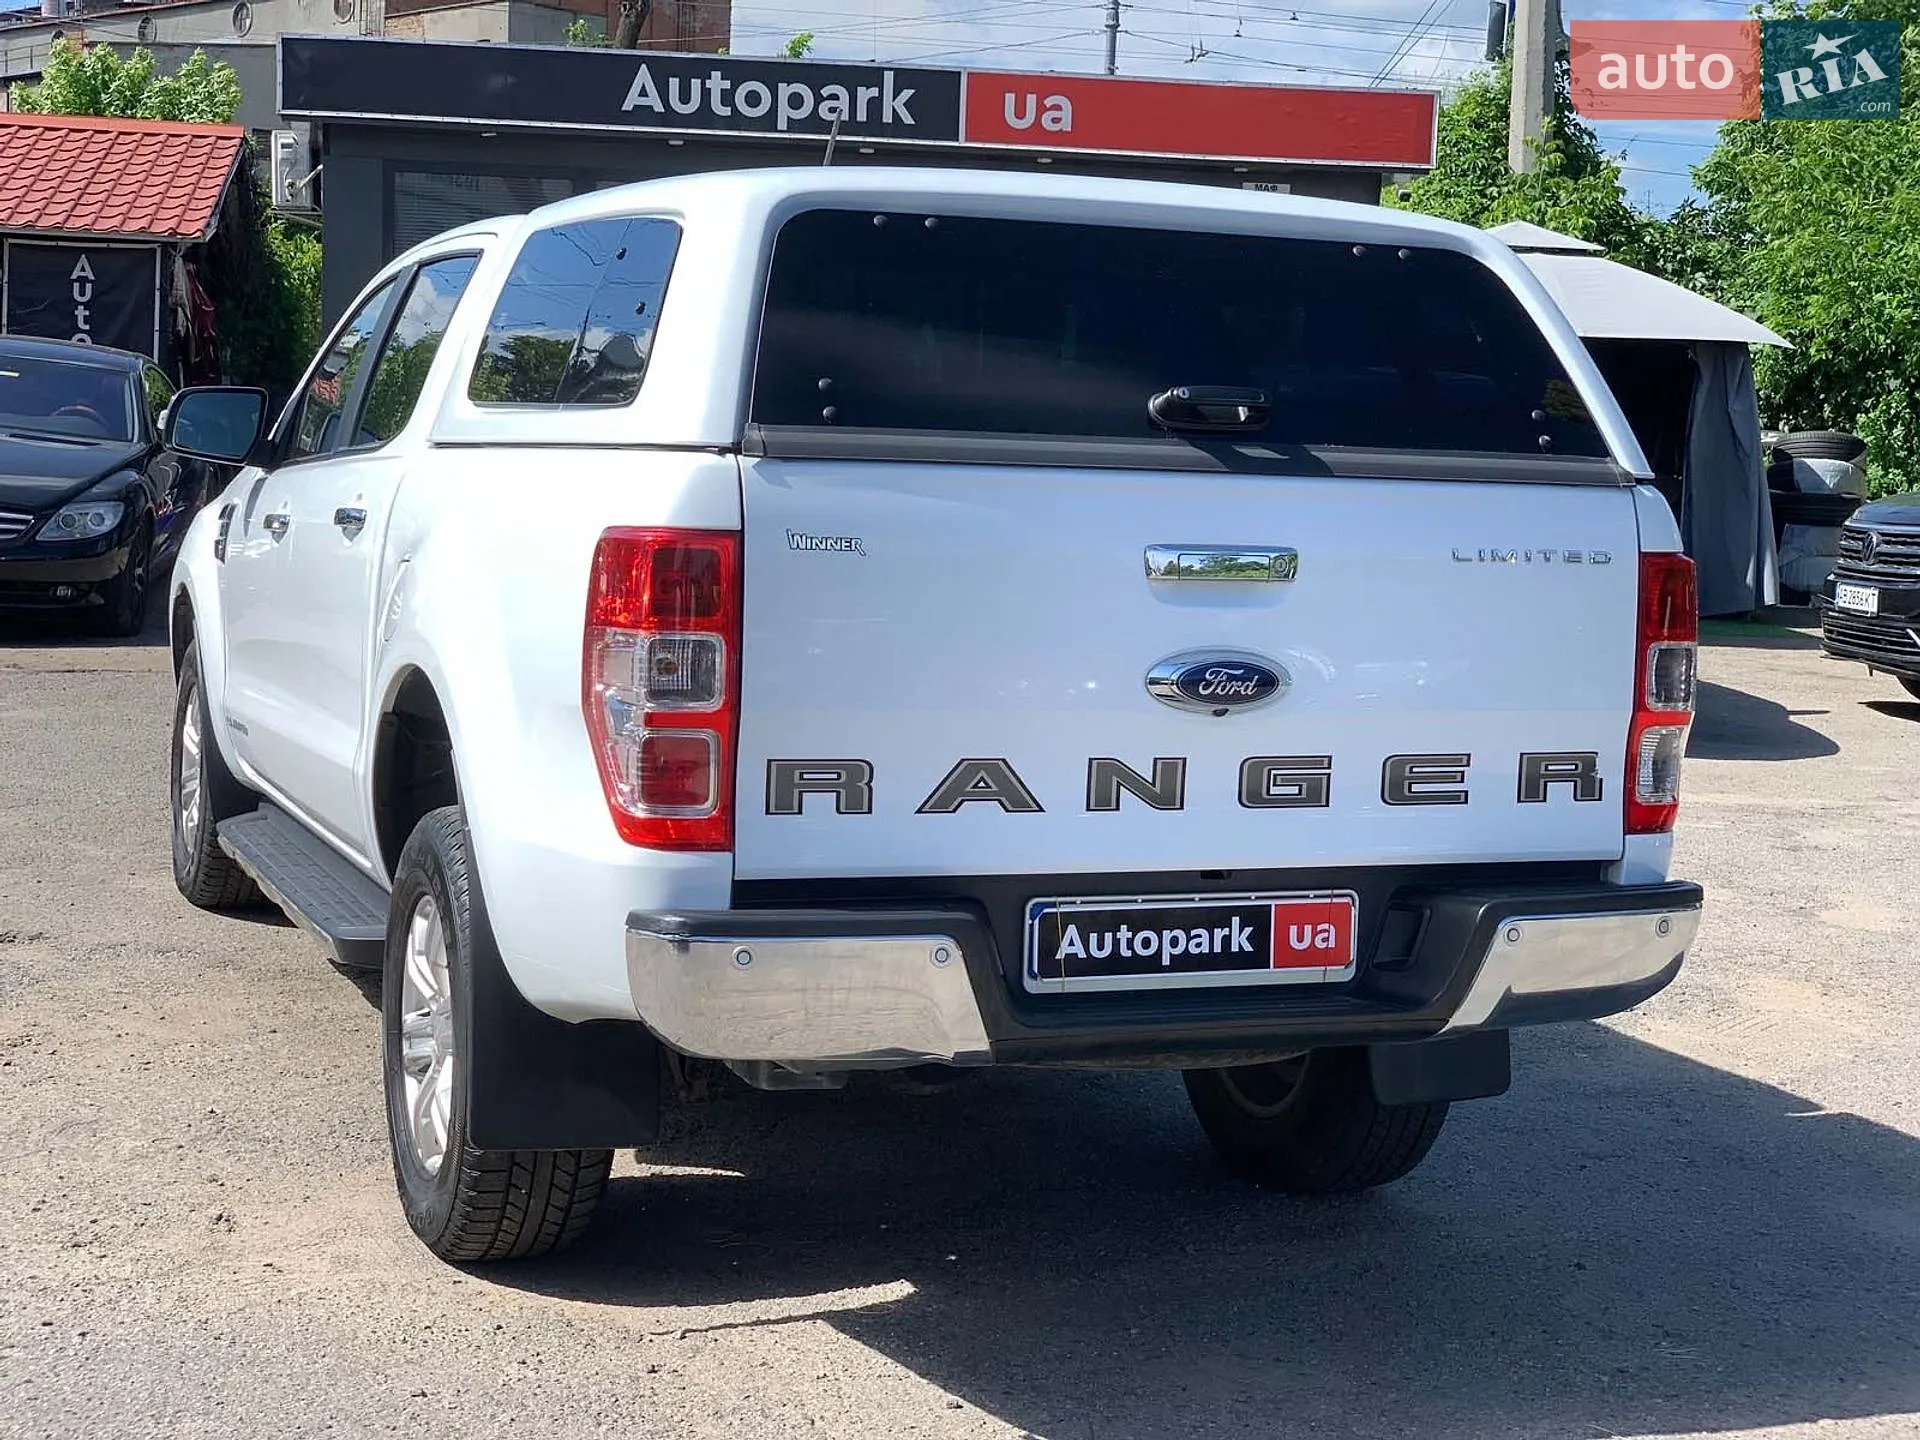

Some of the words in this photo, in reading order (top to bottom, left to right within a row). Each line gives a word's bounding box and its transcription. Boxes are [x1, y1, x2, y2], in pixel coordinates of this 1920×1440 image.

[620, 63, 916, 131] Autopark
[1003, 91, 1074, 132] ua
[785, 528, 867, 557] WINNER
[1452, 548, 1612, 566] LIMITED
[1198, 667, 1259, 695] Ford
[764, 751, 1604, 815] RANGER
[1055, 916, 1254, 966] Autopark
[1288, 921, 1336, 950] ua
